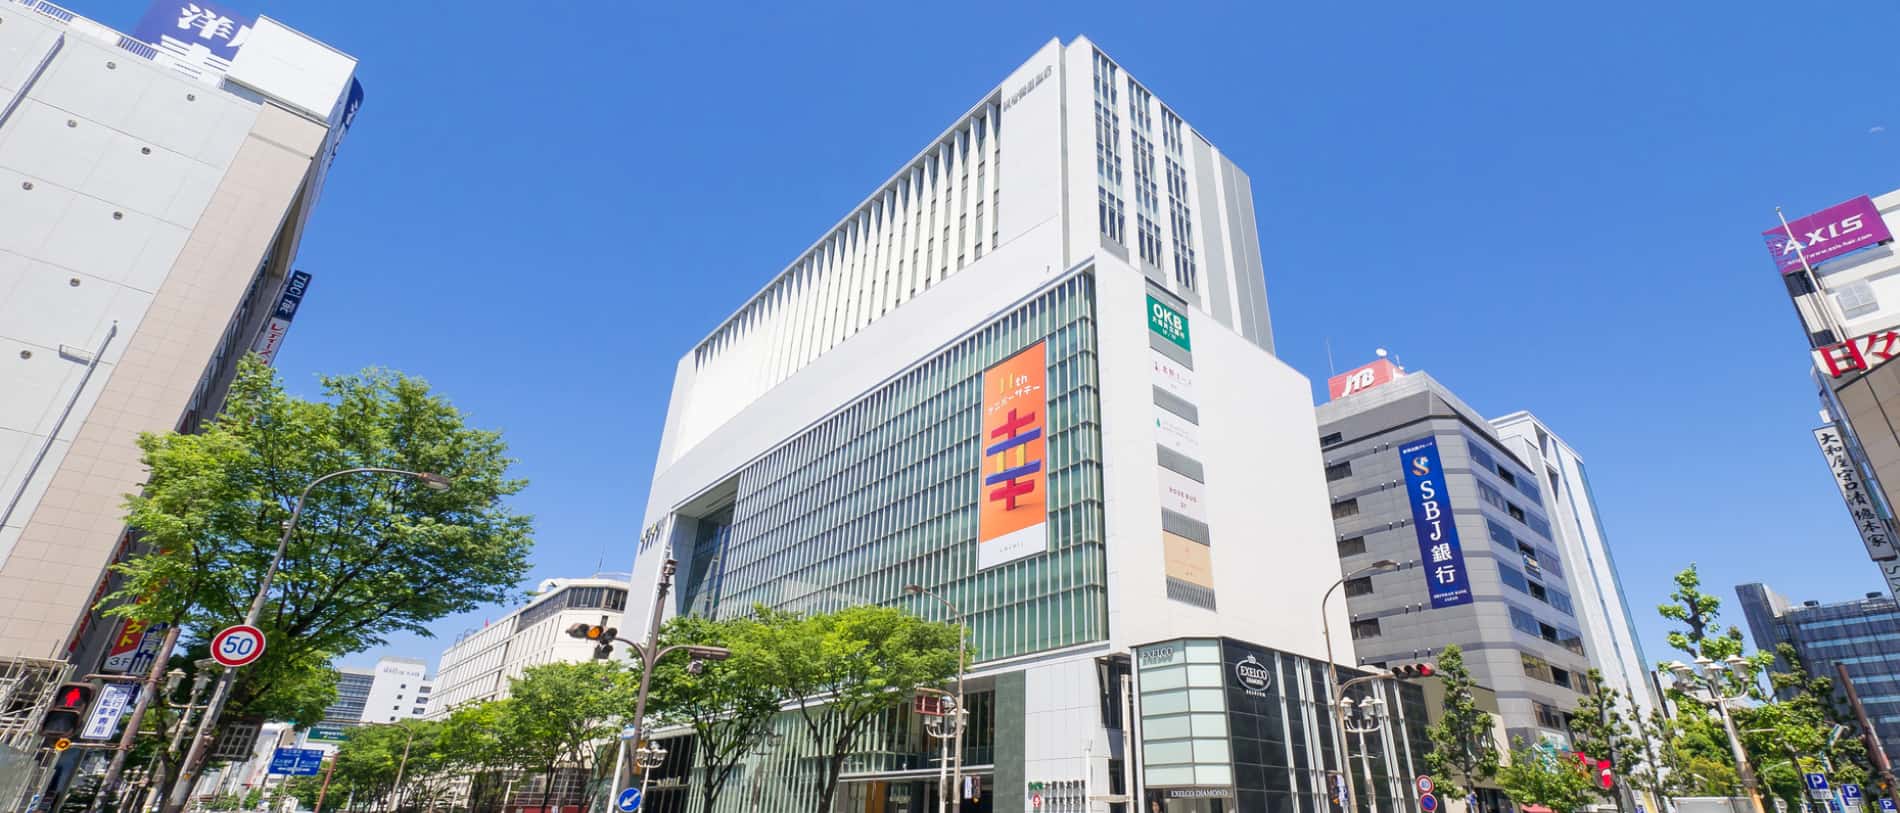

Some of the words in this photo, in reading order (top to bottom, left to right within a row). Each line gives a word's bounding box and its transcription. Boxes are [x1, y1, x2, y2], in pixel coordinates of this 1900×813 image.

[1783, 213, 1864, 256] AXIS
[1153, 303, 1182, 330] OKB
[1341, 367, 1375, 397] JTB
[223, 636, 253, 655] 50
[109, 656, 129, 666] 3F
[1240, 665, 1268, 681] EXELCO
